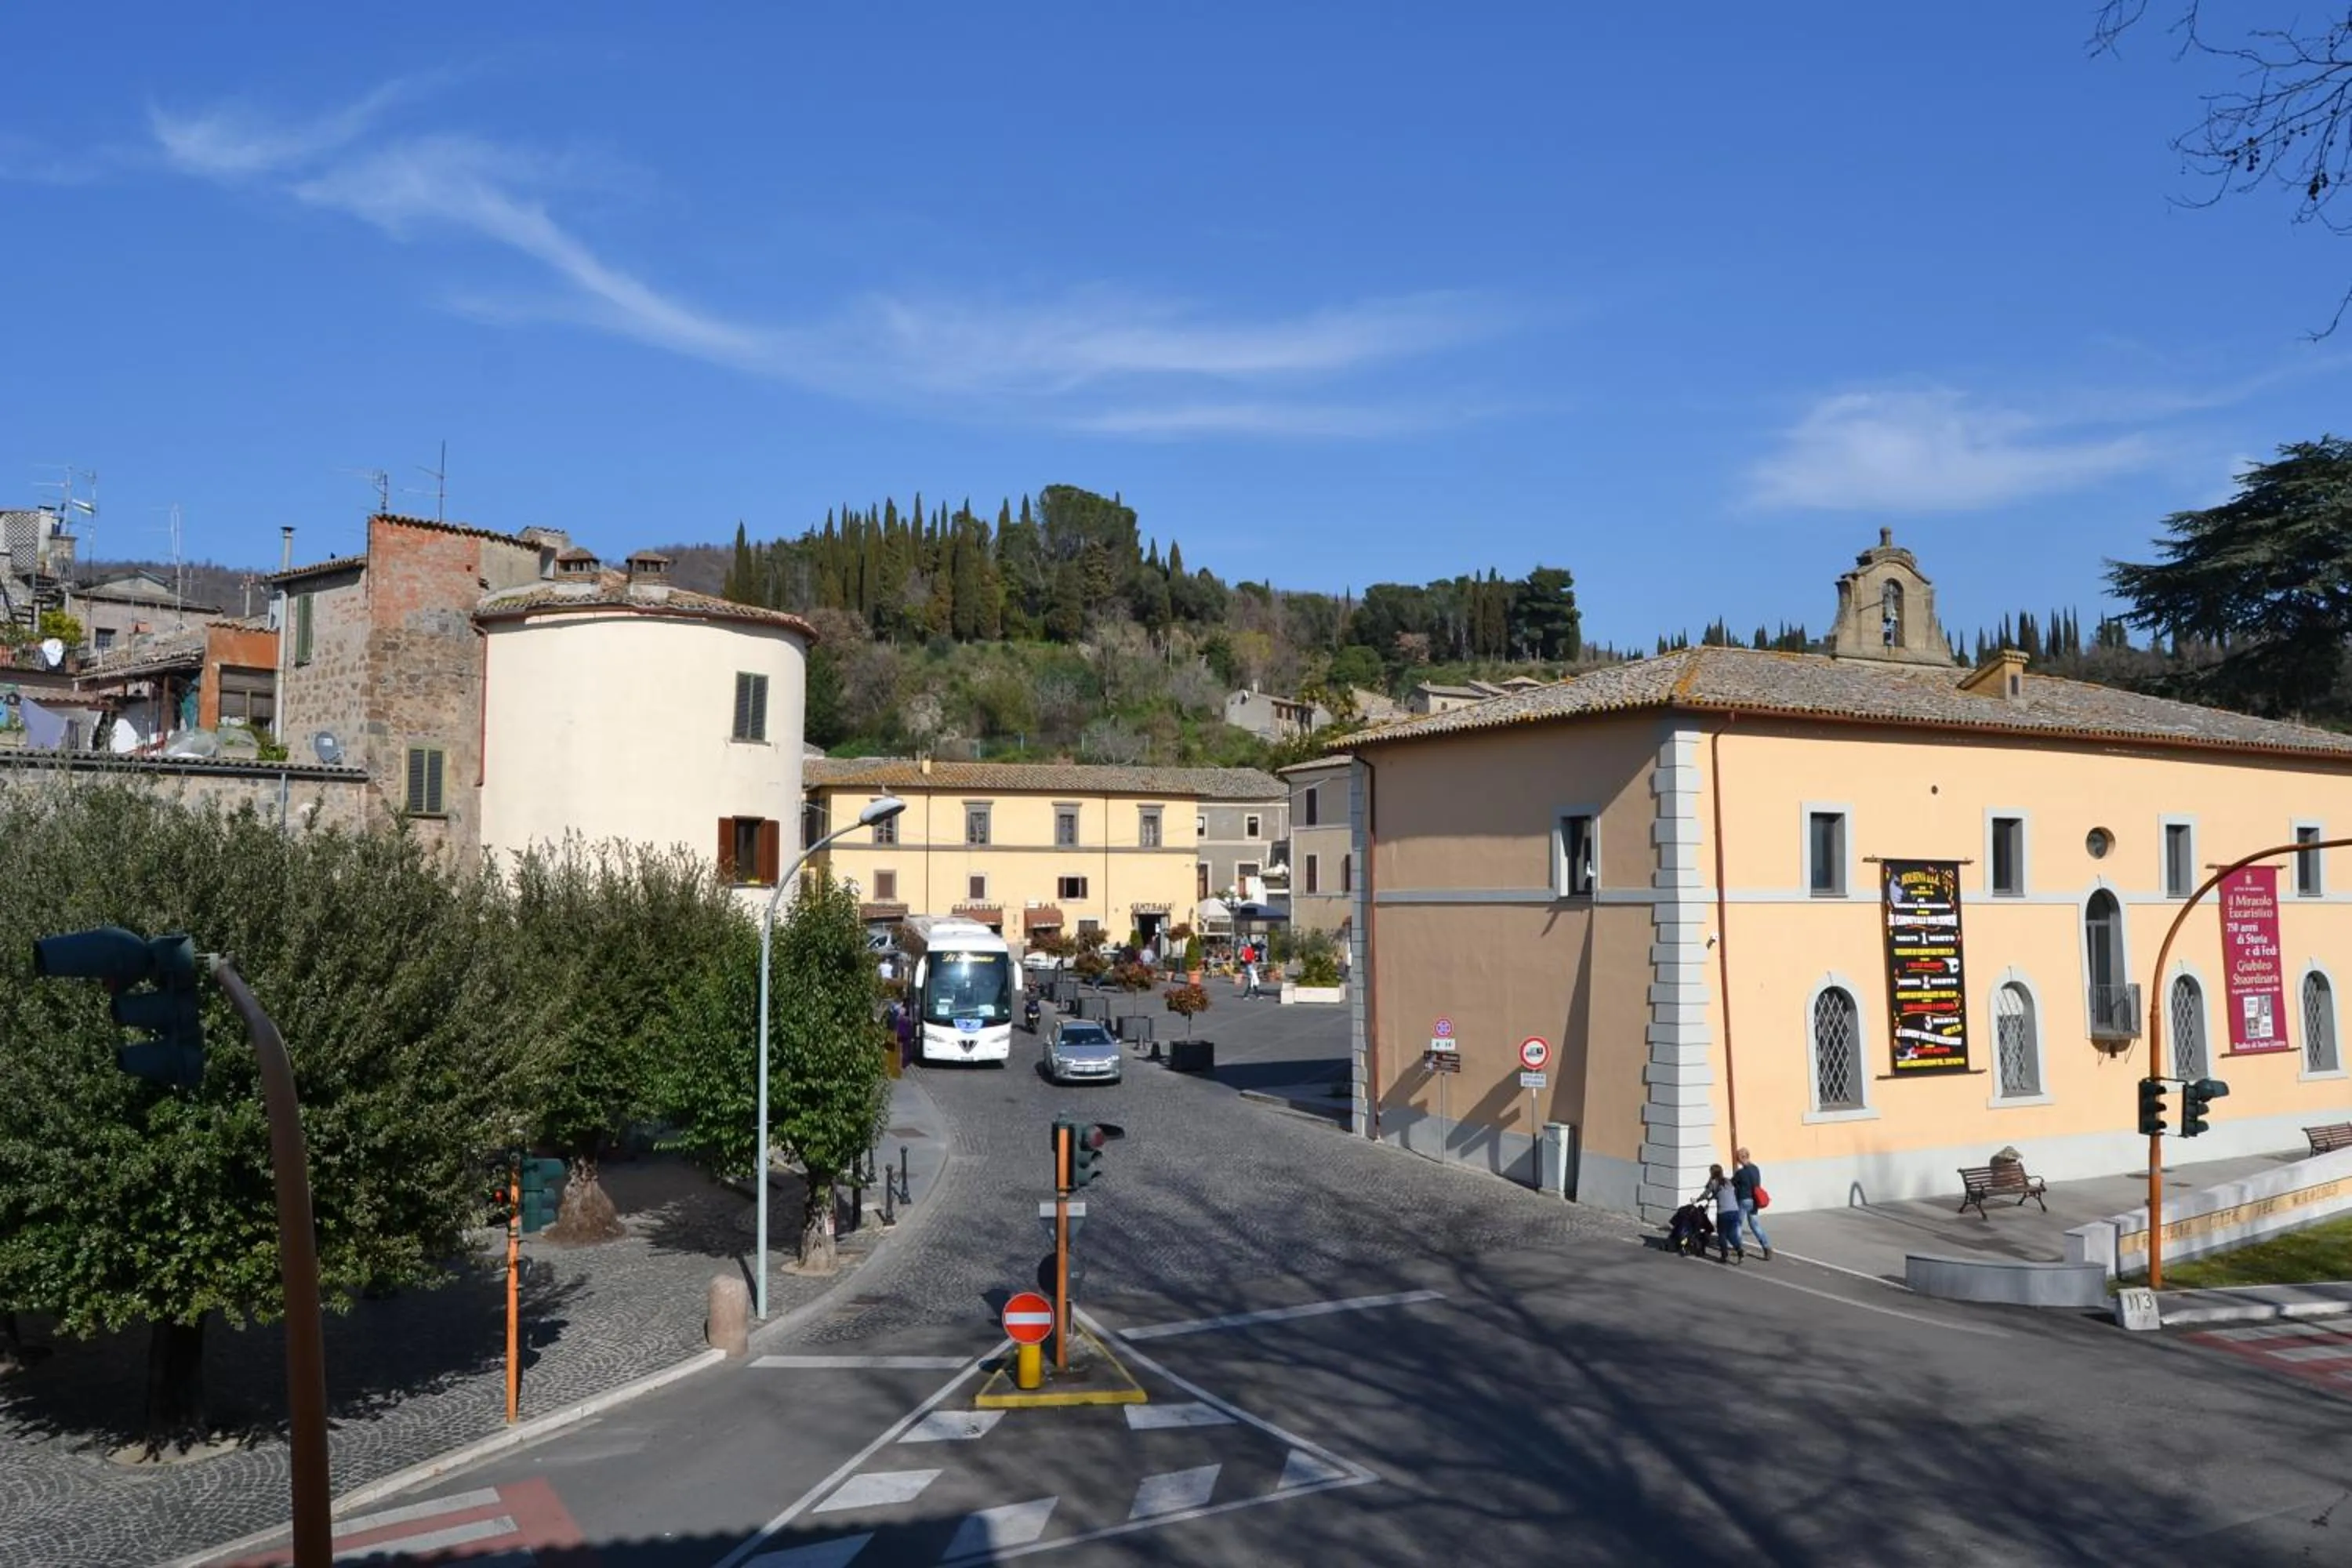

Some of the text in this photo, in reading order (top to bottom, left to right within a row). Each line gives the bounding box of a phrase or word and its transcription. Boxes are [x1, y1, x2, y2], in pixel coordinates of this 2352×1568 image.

[2235, 895, 2273, 906] Miracolo
[2227, 922, 2259, 932] 750 anni
[2237, 933, 2268, 945] di Storia
[2237, 959, 2273, 973] Giubileo
